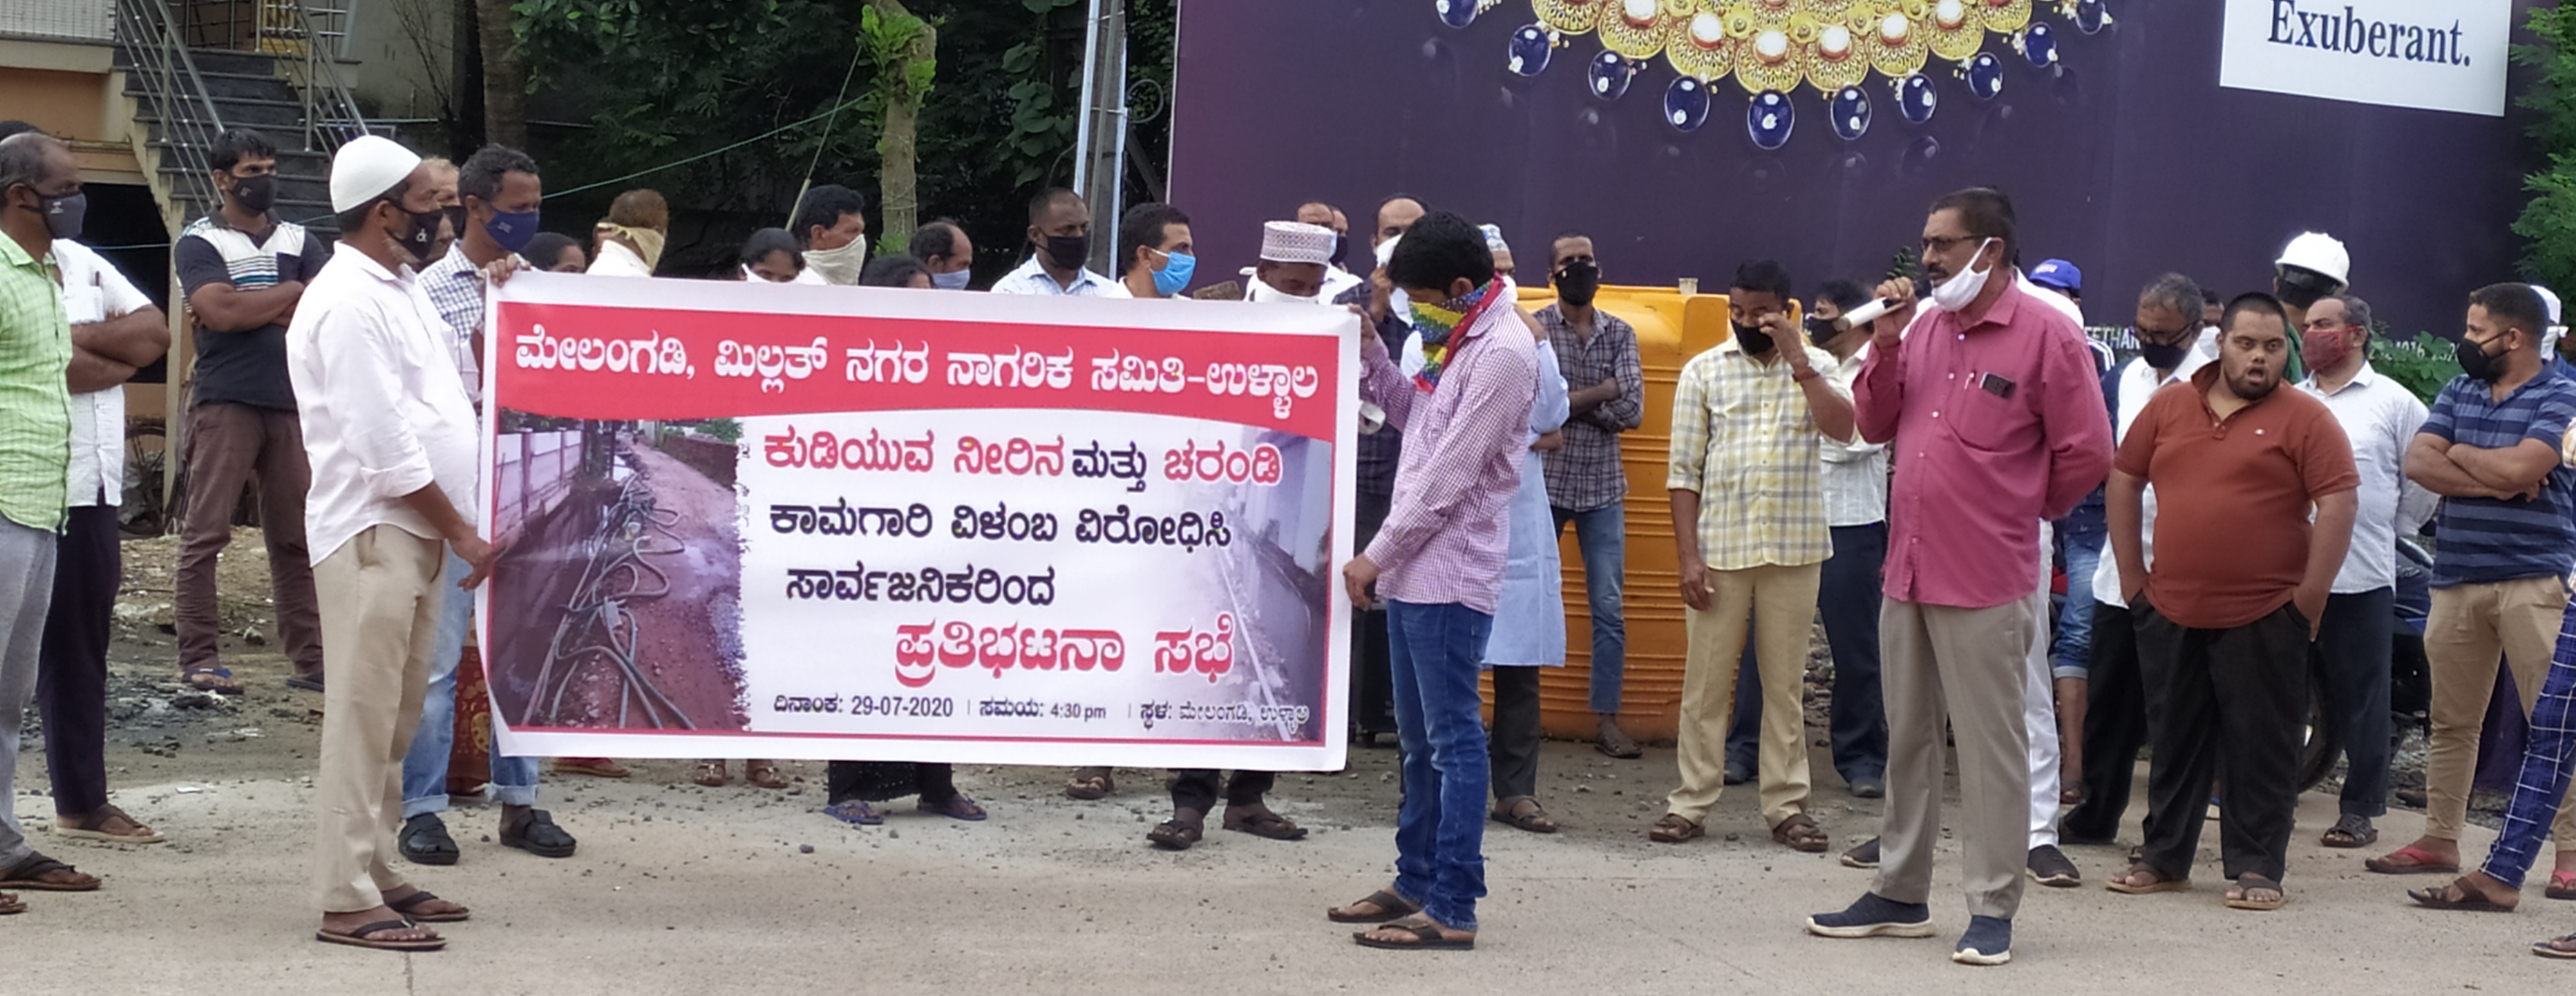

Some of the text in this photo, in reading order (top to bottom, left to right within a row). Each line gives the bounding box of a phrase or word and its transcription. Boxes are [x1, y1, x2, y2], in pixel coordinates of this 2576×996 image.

[2268, 0, 2470, 67] Exuberant.
[516, 323, 696, 380] ಮೇಲಂಗಡಿ,
[714, 336, 828, 393] ಮಿಲ್ಲತ್
[846, 338, 929, 385] ನಗರ
[947, 343, 1074, 388] ನಾಗರಿಕ
[764, 424, 1281, 492] ಕುಡಿಯುವ ನೀರಿನ ಮತ್ತು ಚರಂಡಿ
[770, 496, 1232, 553] ಕಾಮಗಾರಿ ವಿಳಂಬ ವಿರೋಧಿಸಿ
[786, 560, 1056, 606] ಸಾರ್ವಜನಿಕರಿಂದ
[895, 612, 1235, 688] ಪ್ರತಿಭಟನಾ ಸಭೆ
[773, 693, 843, 714] ದಿನಾಂಕ:
[851, 695, 953, 717] 29-07-2020
[1050, 702, 1082, 719] 4:30
[1084, 707, 1106, 722] pm
